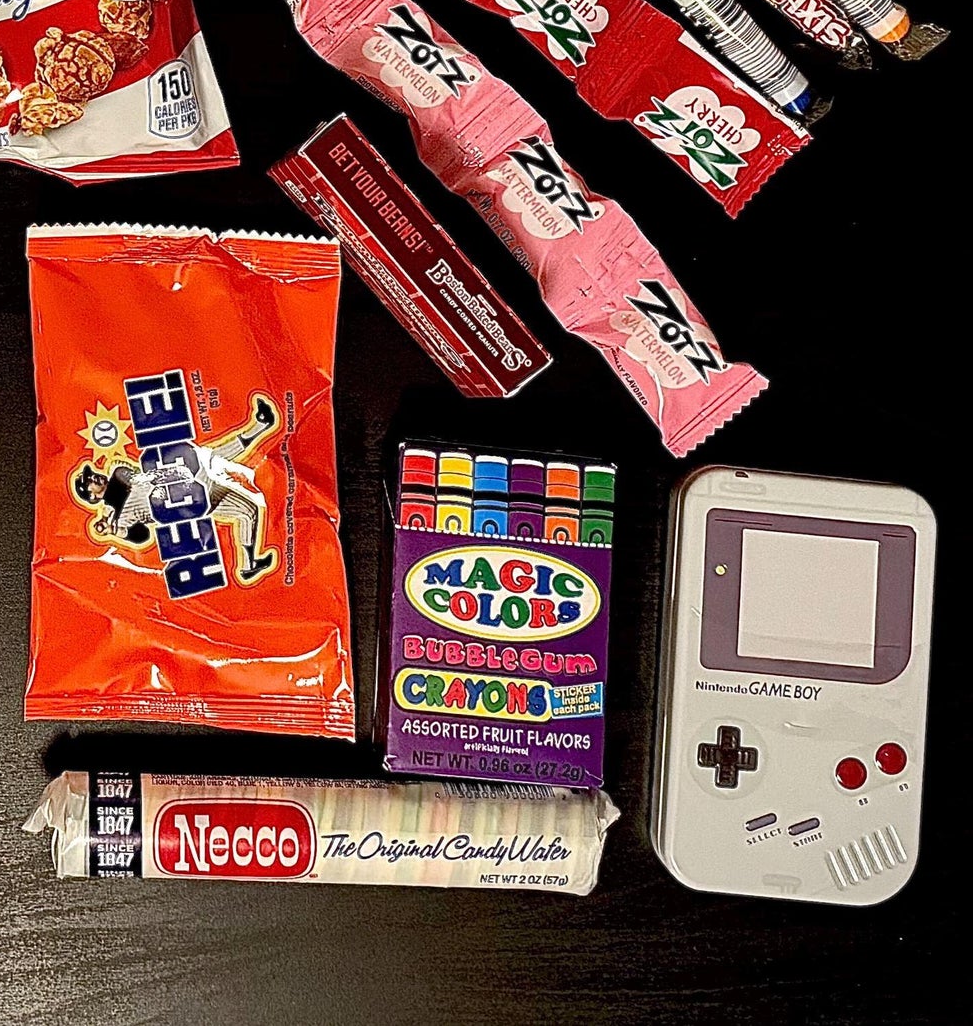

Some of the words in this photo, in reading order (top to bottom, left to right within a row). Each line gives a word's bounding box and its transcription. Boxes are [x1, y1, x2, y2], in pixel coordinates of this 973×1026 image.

[157, 69, 193, 101] 150
[373, 39, 441, 105] WATERMELON
[153, 98, 197, 120] CALORIES
[158, 116, 180, 132] PER
[685, 97, 744, 146] CHERRY
[328, 142, 353, 173] BET
[350, 165, 381, 209] YOUR
[377, 199, 428, 254] BEANS!
[498, 163, 562, 236] WATERMELON
[425, 258, 471, 304] Boston
[468, 296, 498, 333] Baked
[620, 311, 688, 385] WATERMELON
[200, 415, 212, 432] NET
[284, 536, 295, 586] Chocolate
[423, 558, 584, 598] MAGIC
[423, 588, 581, 629] COLORS
[402, 673, 548, 717] CRAYONS
[554, 685, 597, 699] STICKER
[696, 681, 747, 694] Nintendo
[749, 681, 791, 698] GAME
[794, 687, 822, 701] BOY
[553, 705, 576, 715] each
[578, 702, 600, 714] pack
[402, 719, 479, 740] ASSORTED
[483, 727, 523, 744] FRUIT
[527, 730, 591, 750] FLAVORS
[412, 750, 444, 767] NET
[448, 753, 475, 769] WT.
[479, 757, 510, 772] 0.96
[97, 784, 134, 799] 1847
[97, 806, 134, 816] SINCE
[97, 815, 134, 835] 1847
[97, 844, 134, 853] SINCE
[174, 814, 300, 873] Necco
[321, 833, 356, 859] The
[356, 831, 445, 863] Original
[442, 835, 508, 866] Candy
[507, 835, 572, 863] Wafer
[97, 852, 134, 867] 1847
[480, 874, 501, 884] NET
[502, 875, 518, 884] WT
[528, 876, 542, 885] OZ
